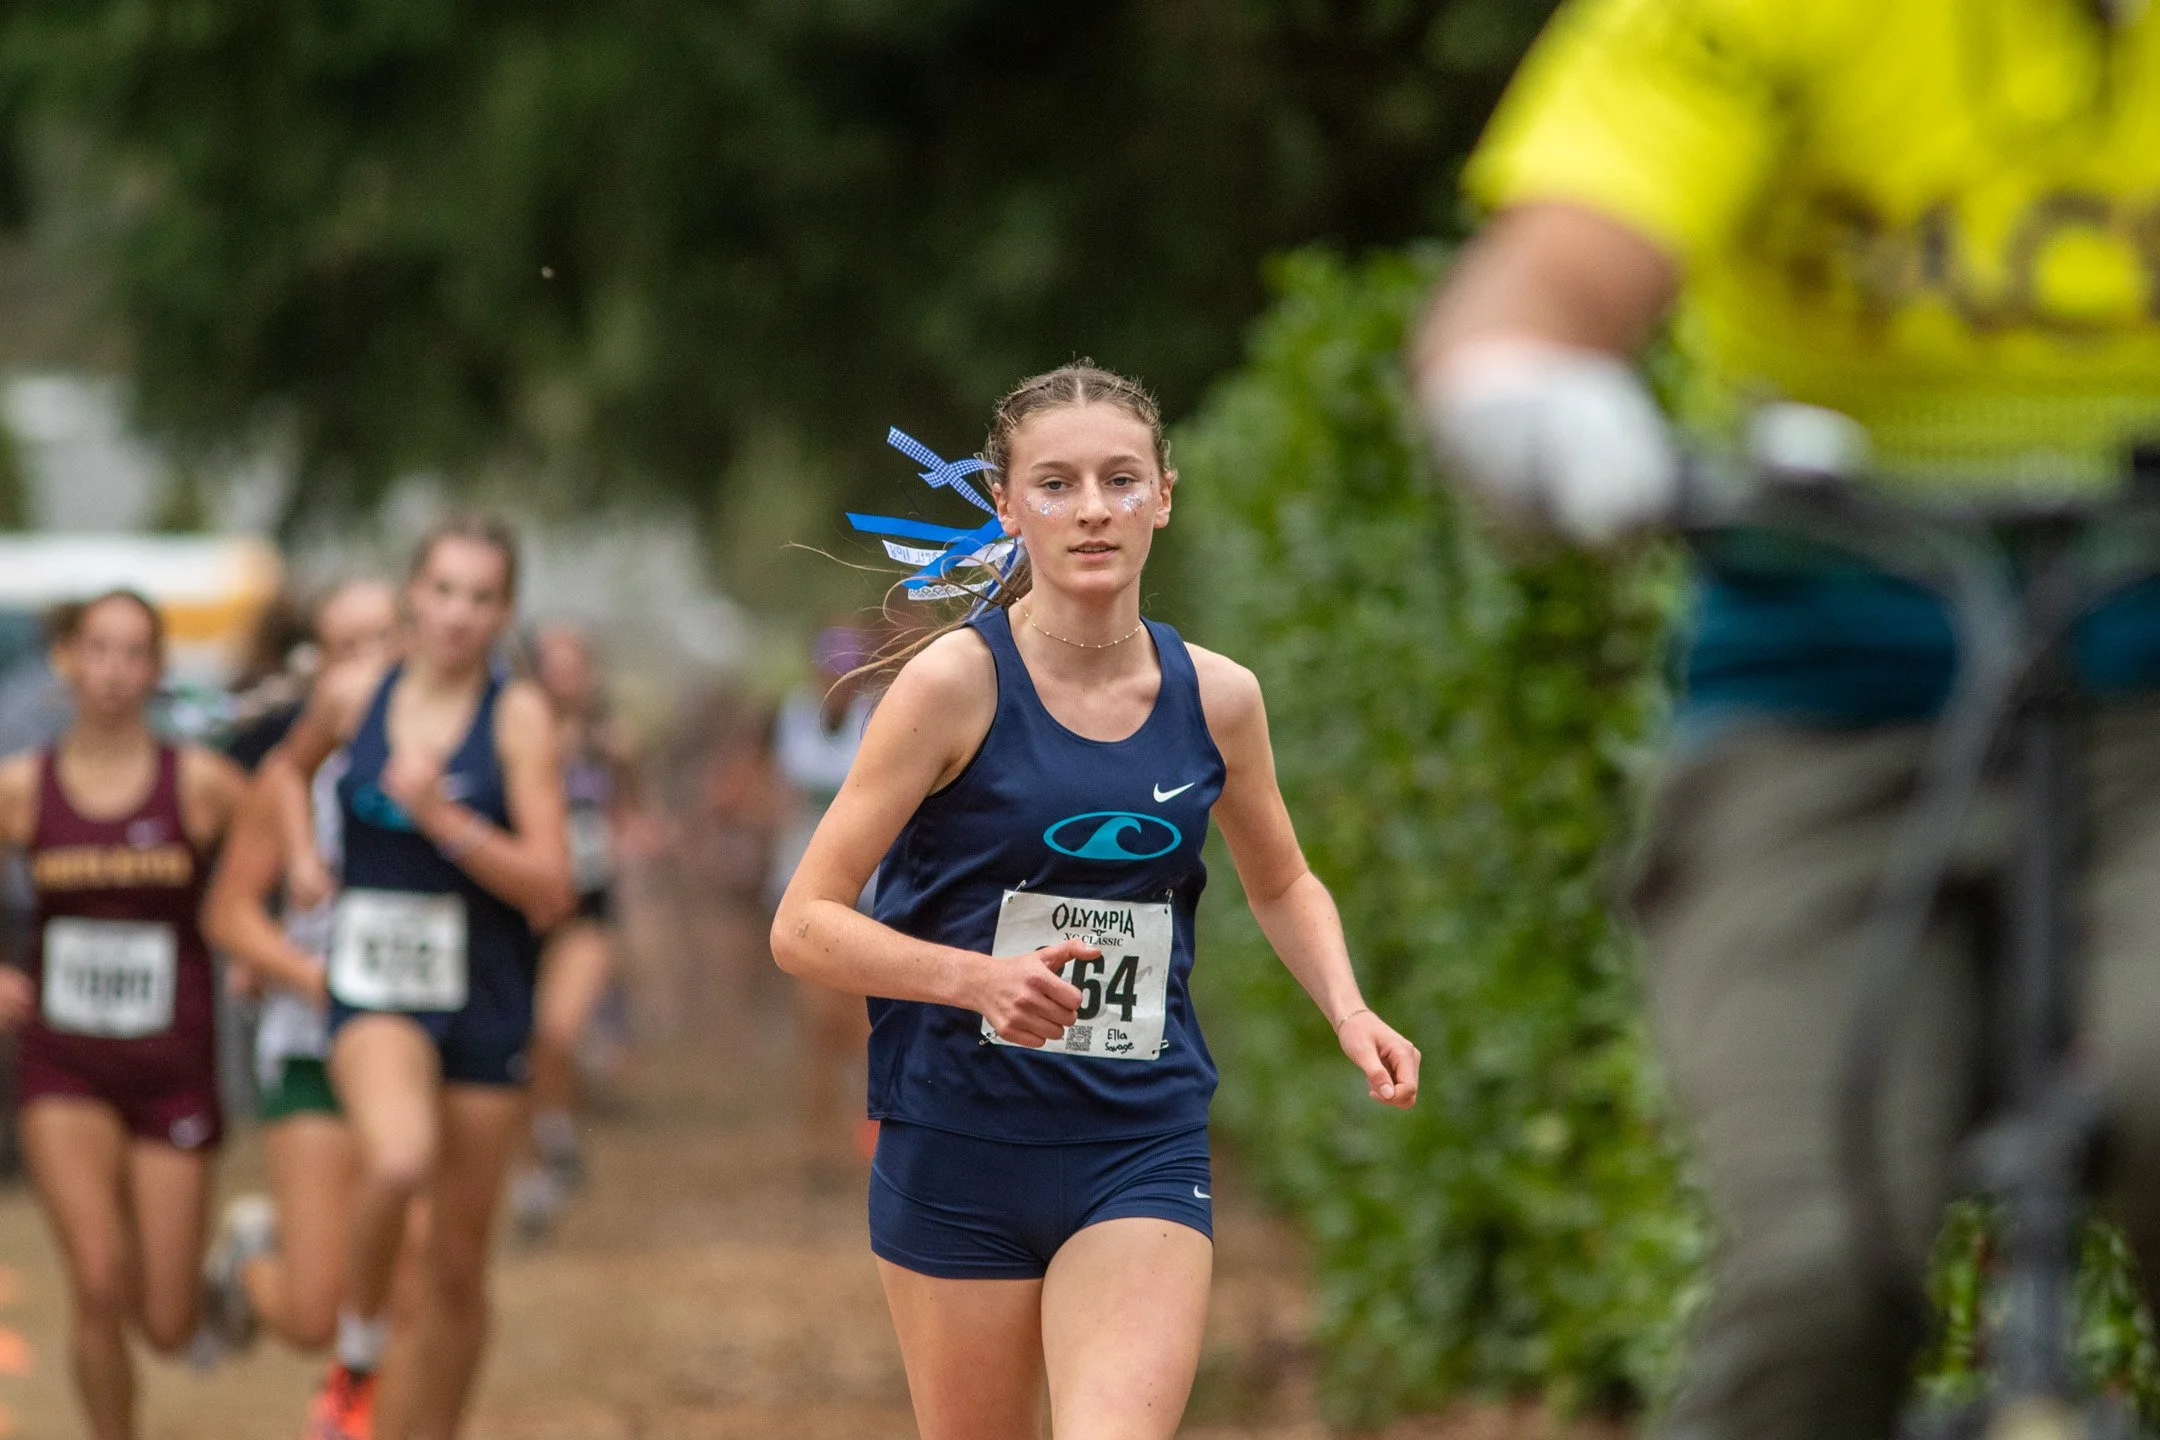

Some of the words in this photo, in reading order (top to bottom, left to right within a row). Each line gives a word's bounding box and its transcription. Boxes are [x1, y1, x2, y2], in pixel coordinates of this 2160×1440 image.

[1052, 902, 1135, 938] OLYMPIA
[1081, 935, 1124, 947] CLASSIC
[1035, 945, 1140, 1022] 64
[1107, 1028, 1128, 1040] Ella
[1105, 1041, 1134, 1054] Savage
